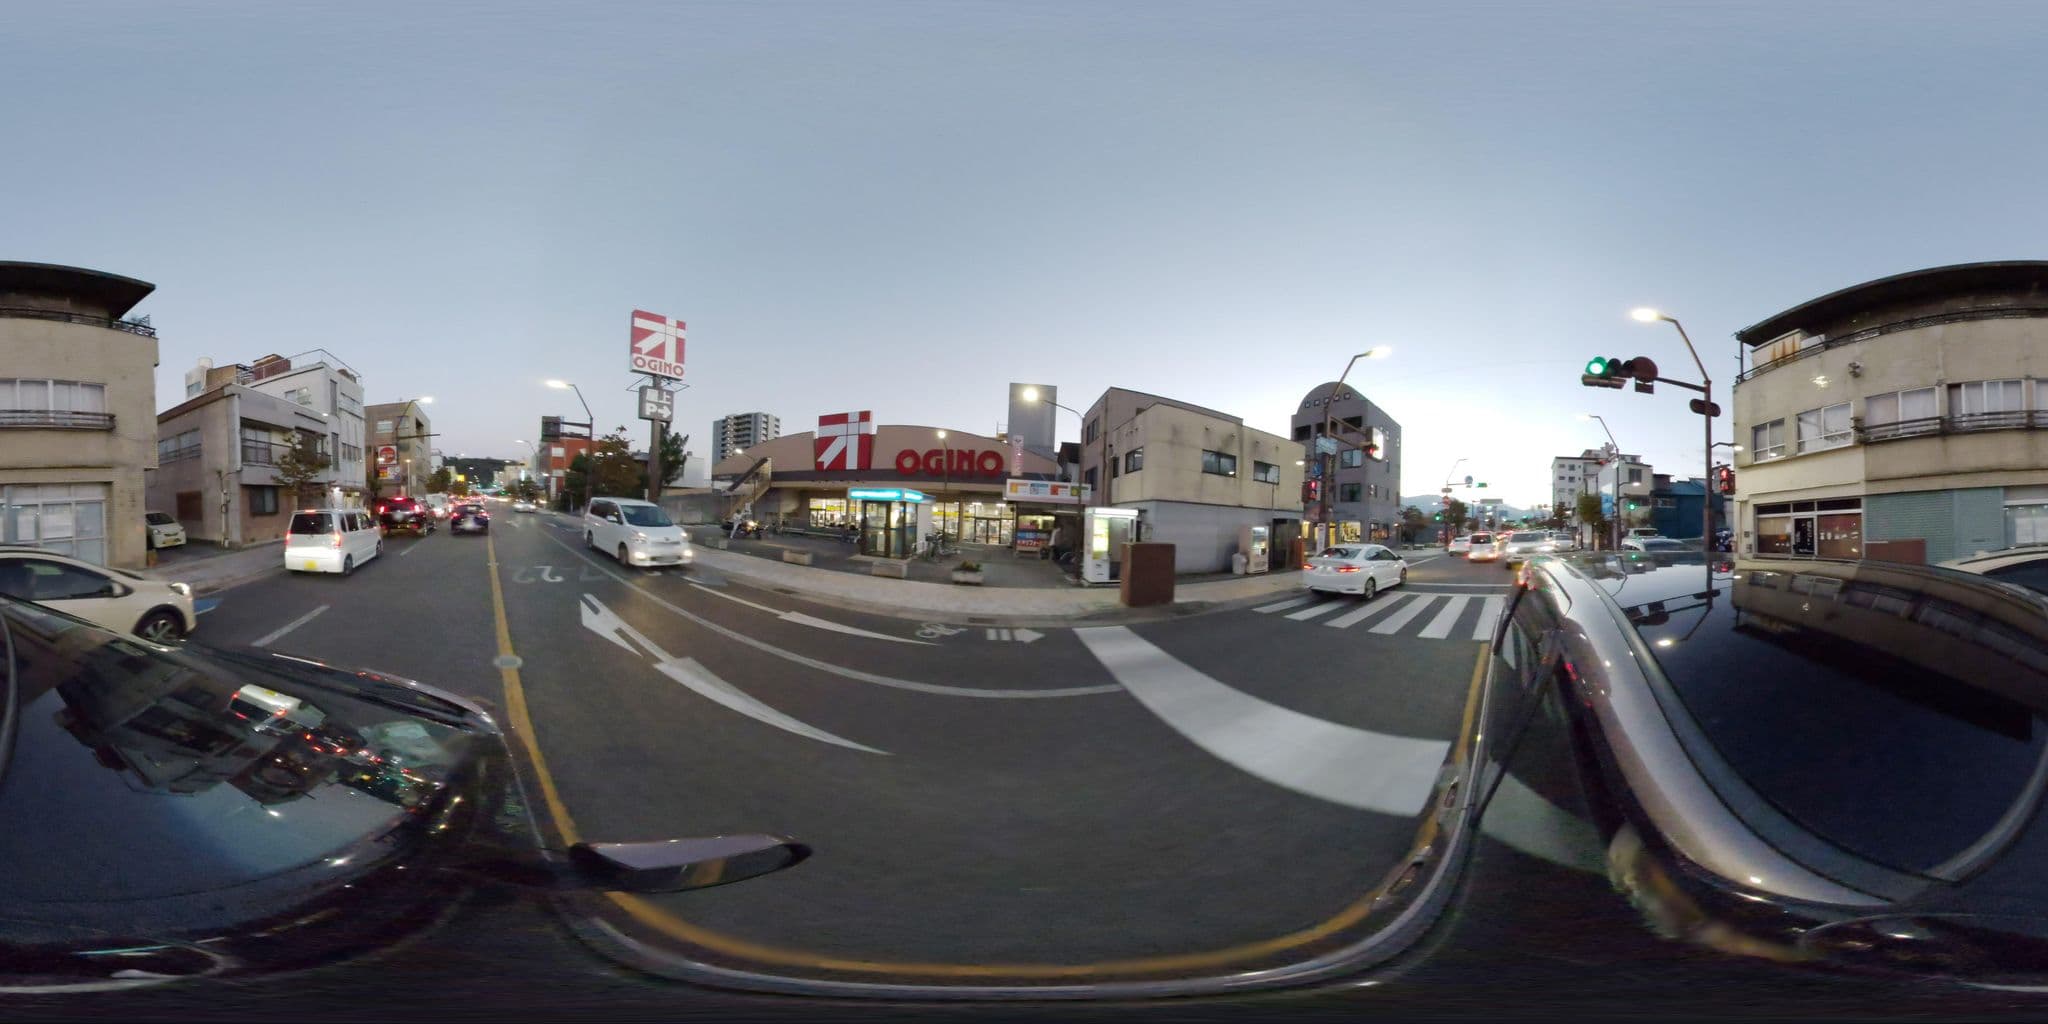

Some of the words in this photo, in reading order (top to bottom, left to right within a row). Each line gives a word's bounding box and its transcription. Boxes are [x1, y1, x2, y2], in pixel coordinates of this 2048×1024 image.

[633, 356, 685, 377] OGINO
[645, 402, 658, 416] P
[896, 448, 1004, 478] OGINO
